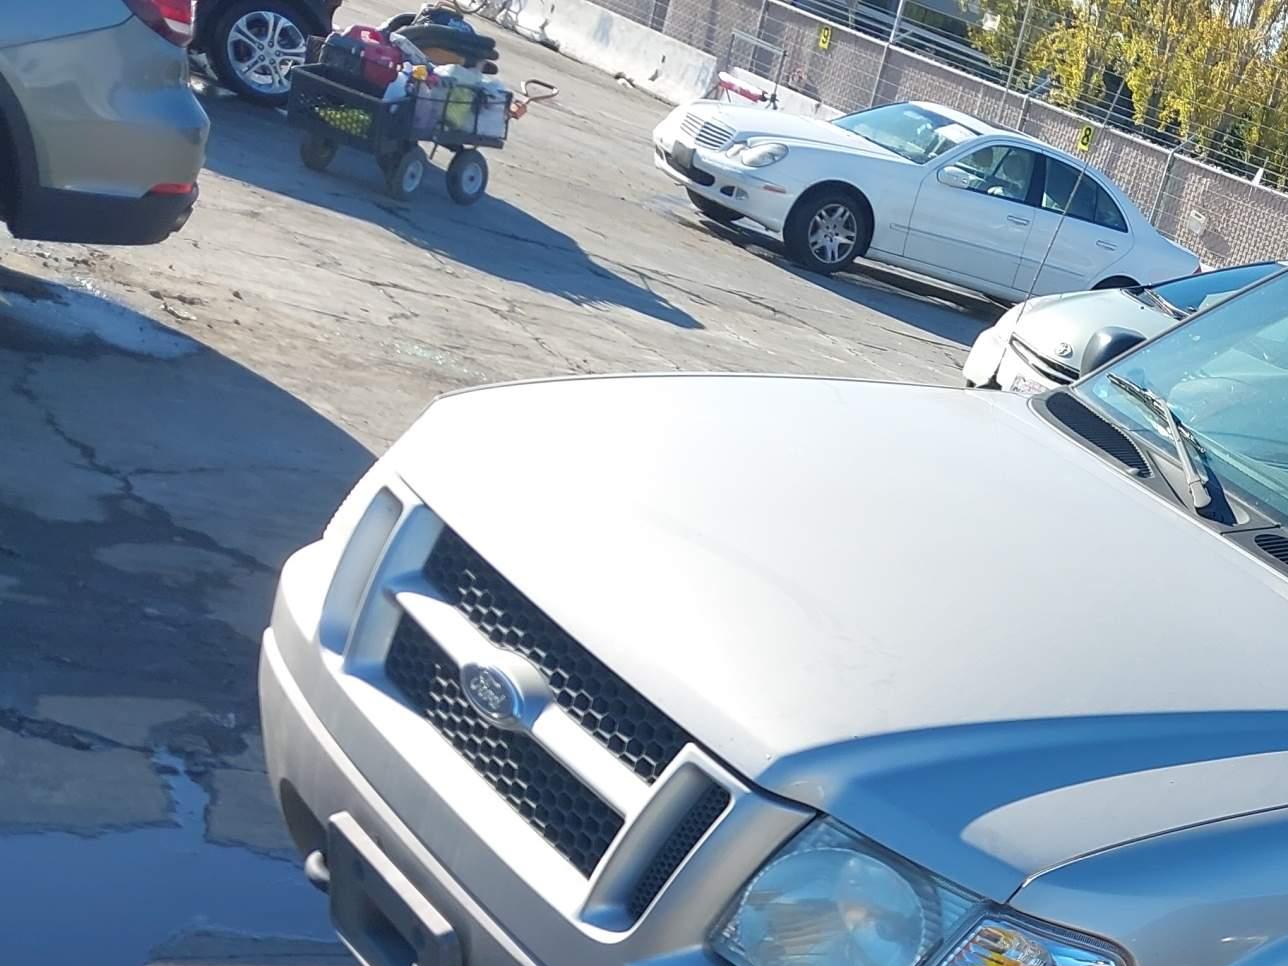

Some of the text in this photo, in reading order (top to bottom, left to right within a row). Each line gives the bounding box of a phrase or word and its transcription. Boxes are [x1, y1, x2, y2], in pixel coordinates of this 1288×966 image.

[822, 27, 830, 45] 9
[1081, 127, 1092, 146] 8
[470, 671, 506, 710] Ford
